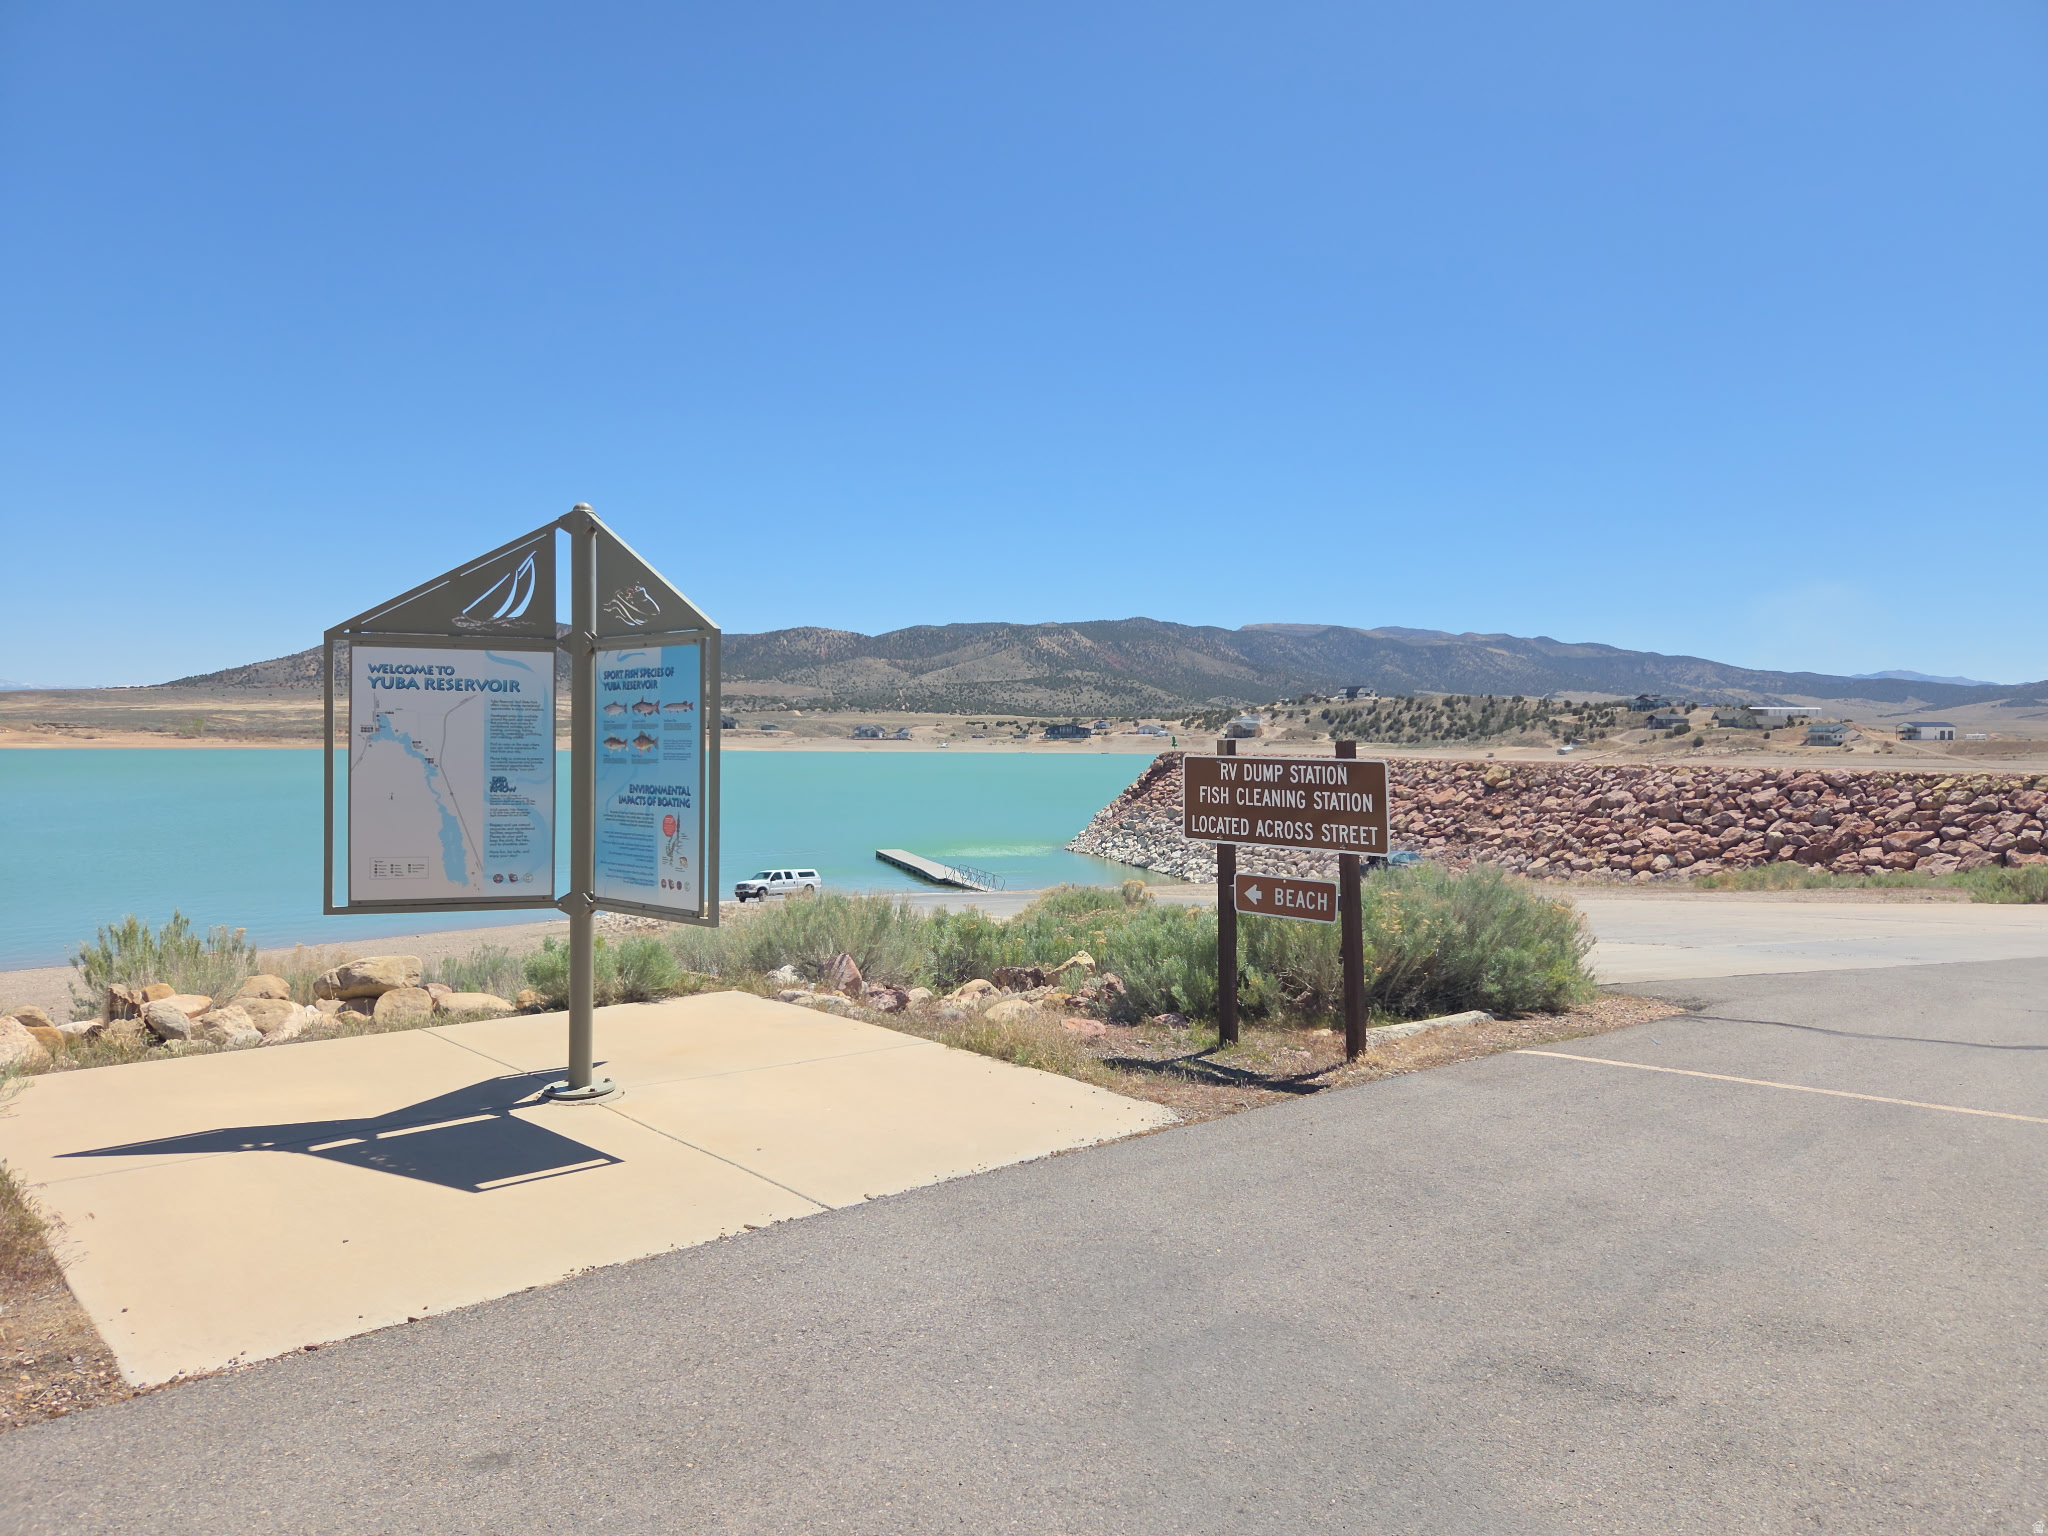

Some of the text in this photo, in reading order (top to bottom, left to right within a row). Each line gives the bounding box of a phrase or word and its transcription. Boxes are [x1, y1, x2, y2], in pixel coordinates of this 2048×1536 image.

[368, 663, 455, 676] WELCOME TO
[603, 666, 675, 680] SPORT FISH SPECIES OF
[367, 676, 521, 693] YUBA RESERVOIR
[603, 679, 658, 691] YUBA RESERVOIR
[1220, 763, 1348, 785] RV DUMP STATION
[629, 784, 691, 796] ENVIRONMENTAL
[619, 795, 691, 808] IMPACTS OF BOATING
[1200, 786, 1373, 813] FISH CLEANING STATION
[1191, 815, 1378, 846] LOCATED ACROSS STREET
[1274, 887, 1328, 911] BEACH
